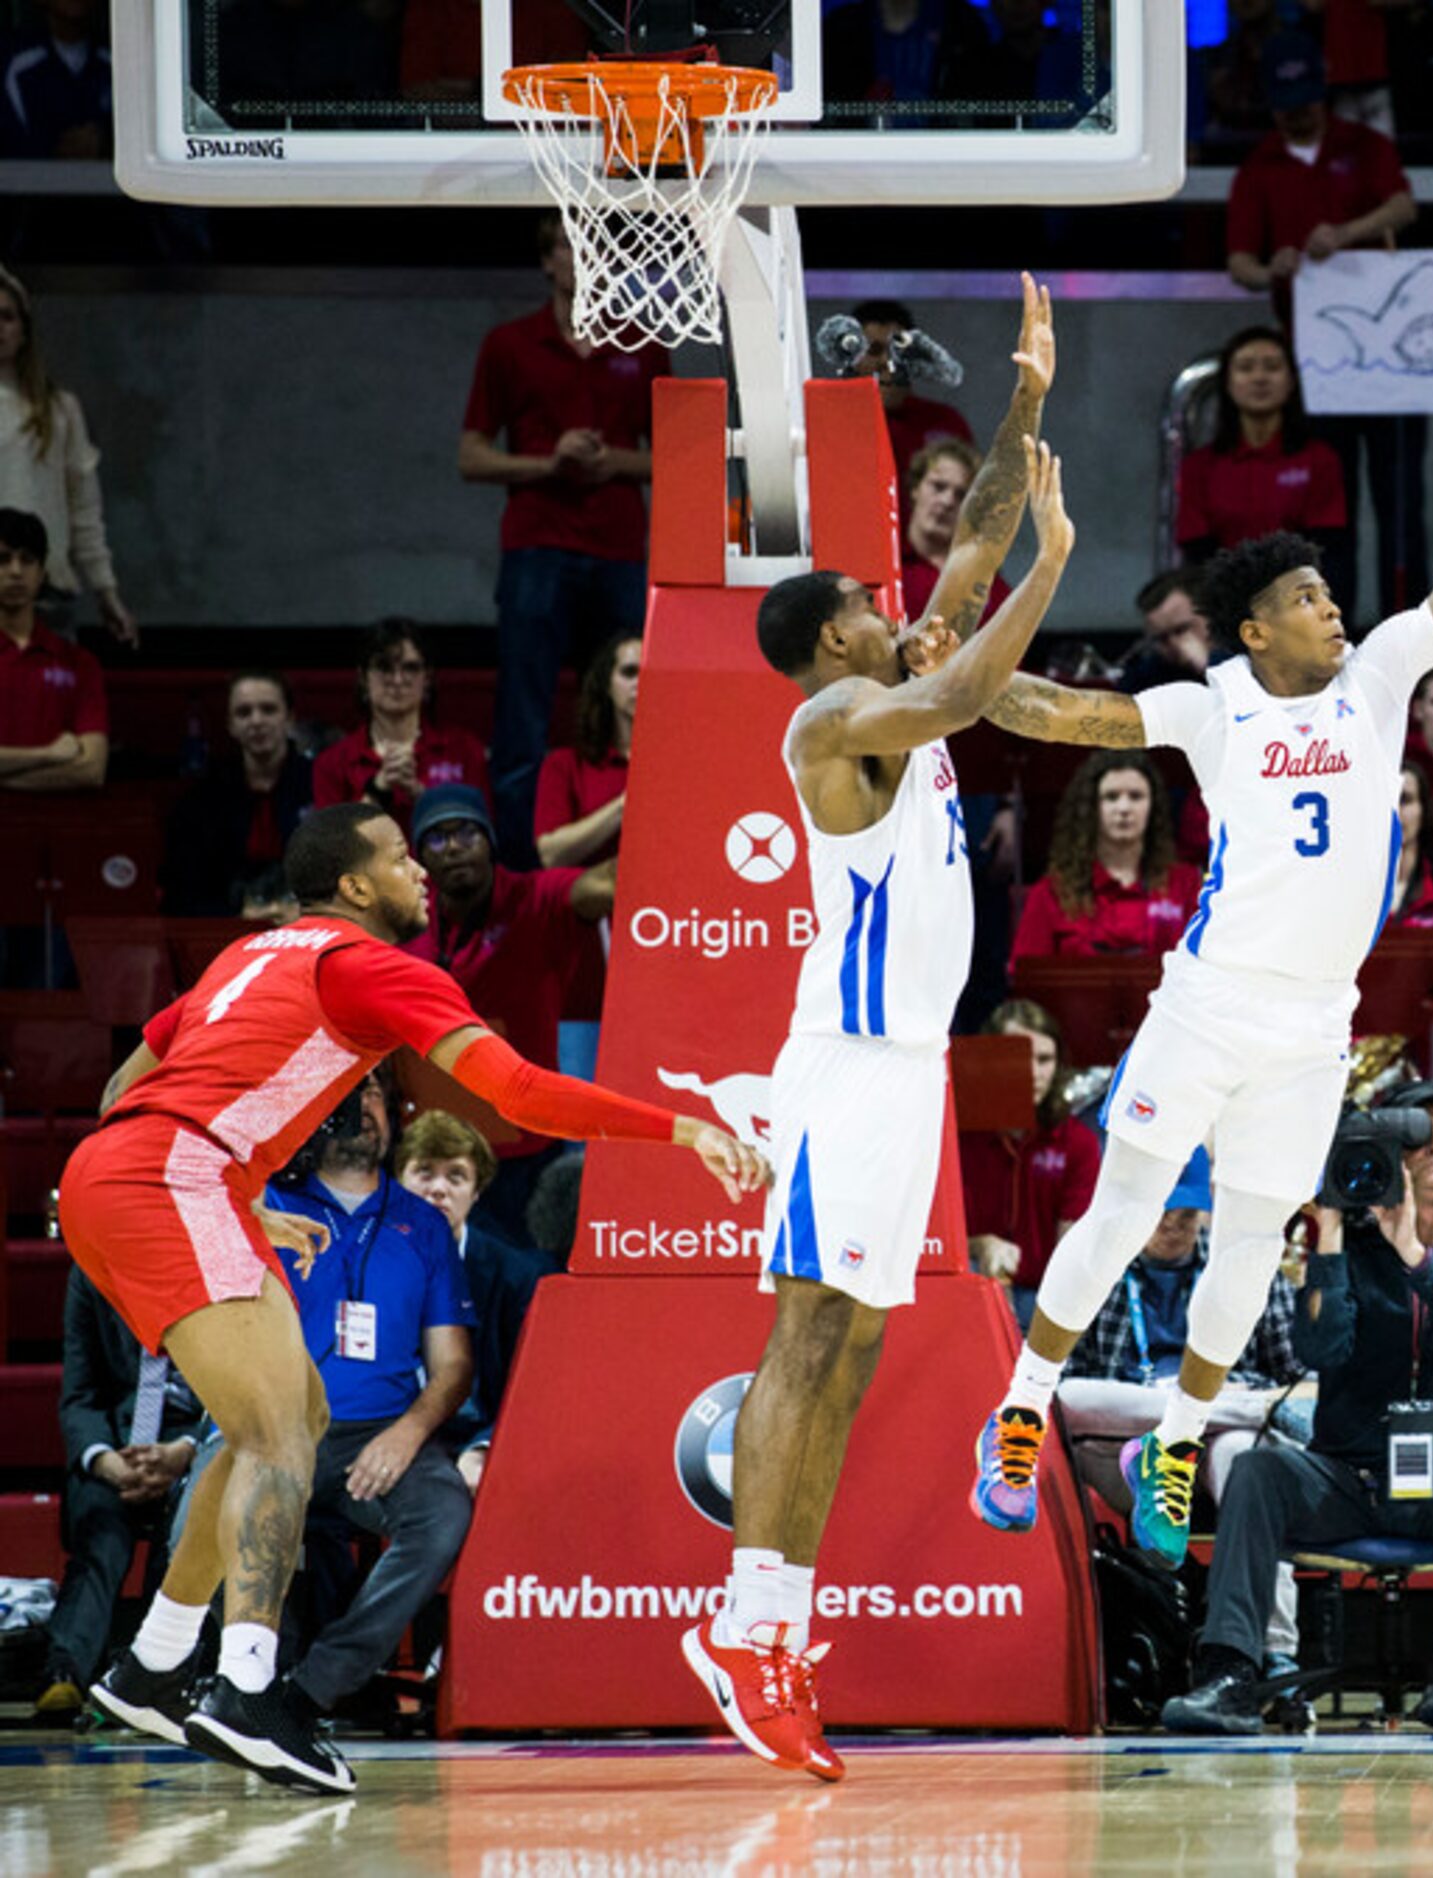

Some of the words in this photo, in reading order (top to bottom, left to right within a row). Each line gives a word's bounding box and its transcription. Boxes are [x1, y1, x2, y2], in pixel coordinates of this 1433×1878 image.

[186, 137, 285, 160] SPALDING
[1259, 738, 1352, 779] Dallas
[1292, 791, 1330, 858] 3
[631, 906, 769, 958] Origin
